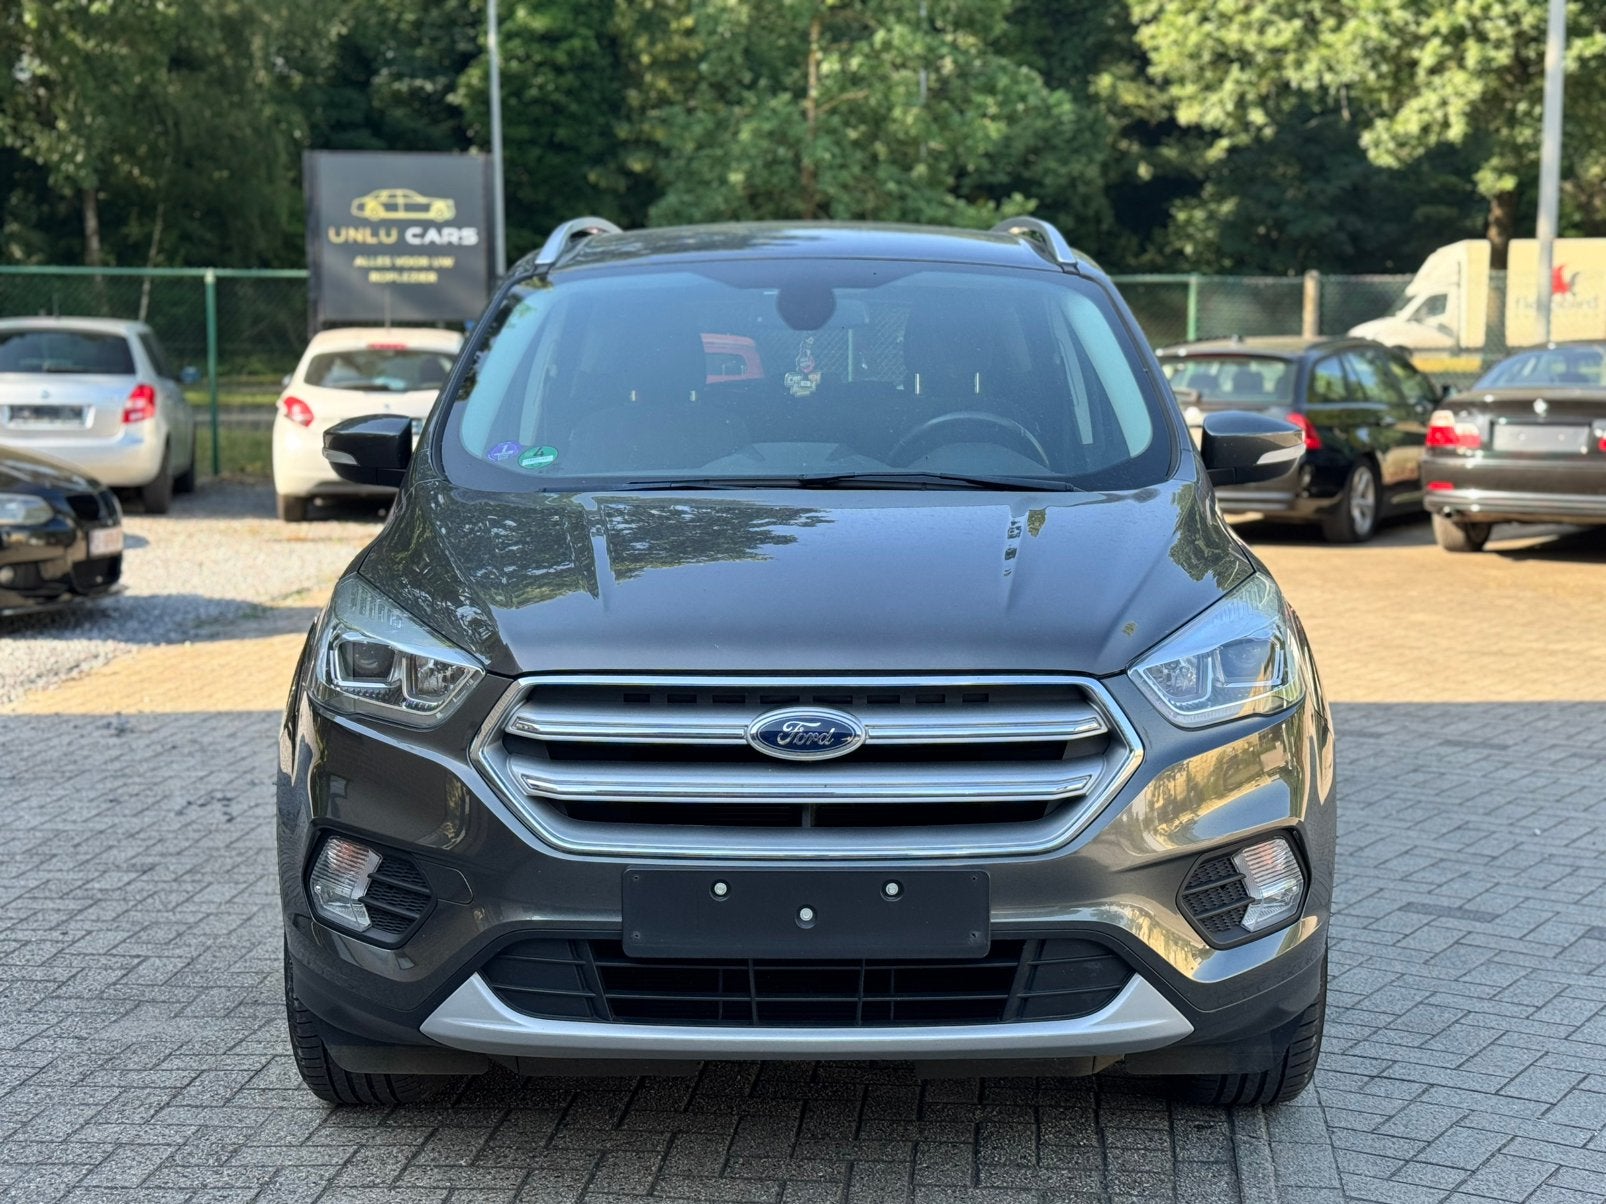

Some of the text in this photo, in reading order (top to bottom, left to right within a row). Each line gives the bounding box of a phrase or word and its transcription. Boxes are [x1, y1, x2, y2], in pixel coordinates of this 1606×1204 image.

[328, 226, 479, 245] UNLU CARS
[777, 720, 836, 746] Ford
